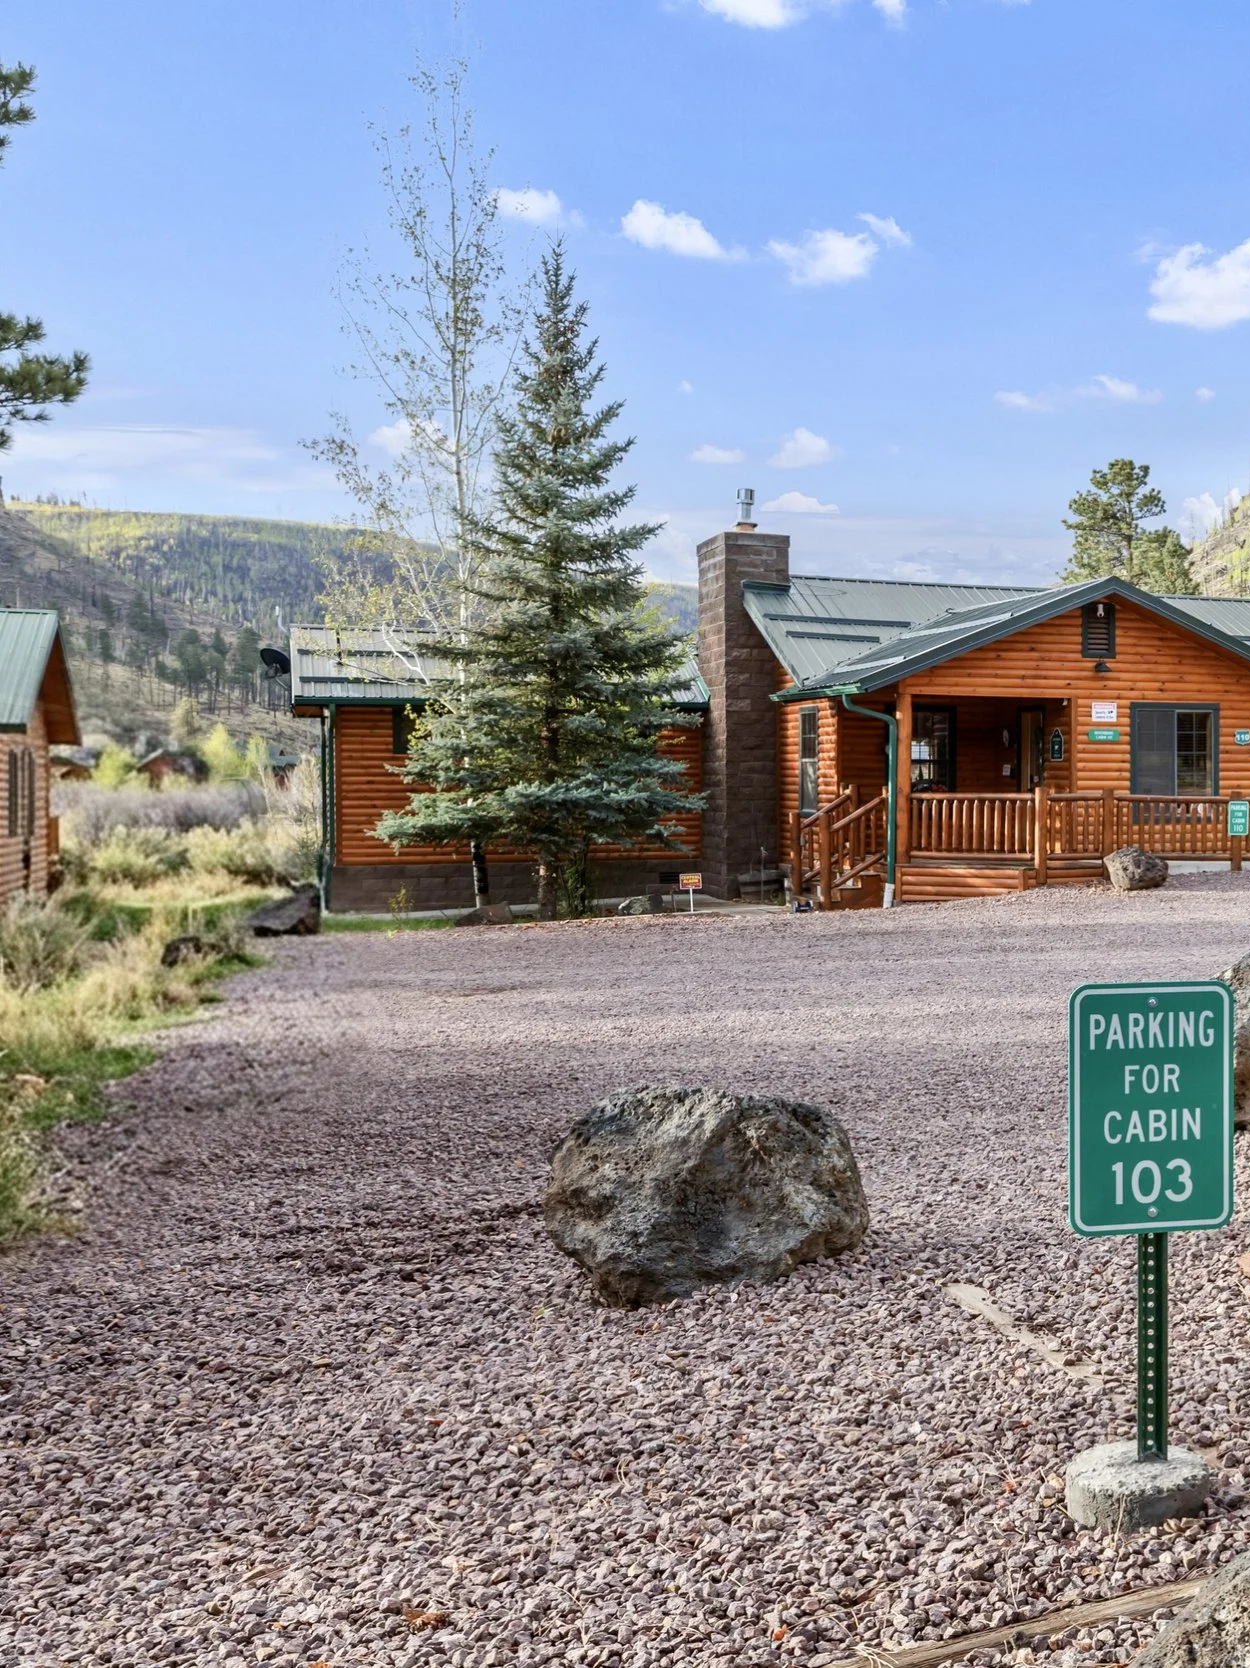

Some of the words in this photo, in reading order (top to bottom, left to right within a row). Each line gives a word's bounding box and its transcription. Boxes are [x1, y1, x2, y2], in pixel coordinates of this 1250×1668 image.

[1236, 733, 1250, 741] 110
[1233, 824, 1244, 832] 110
[1088, 1010, 1215, 1051] PARKING
[1124, 1064, 1181, 1095] FOR
[1104, 1107, 1201, 1145] CABIN
[1111, 1158, 1194, 1205] 103
